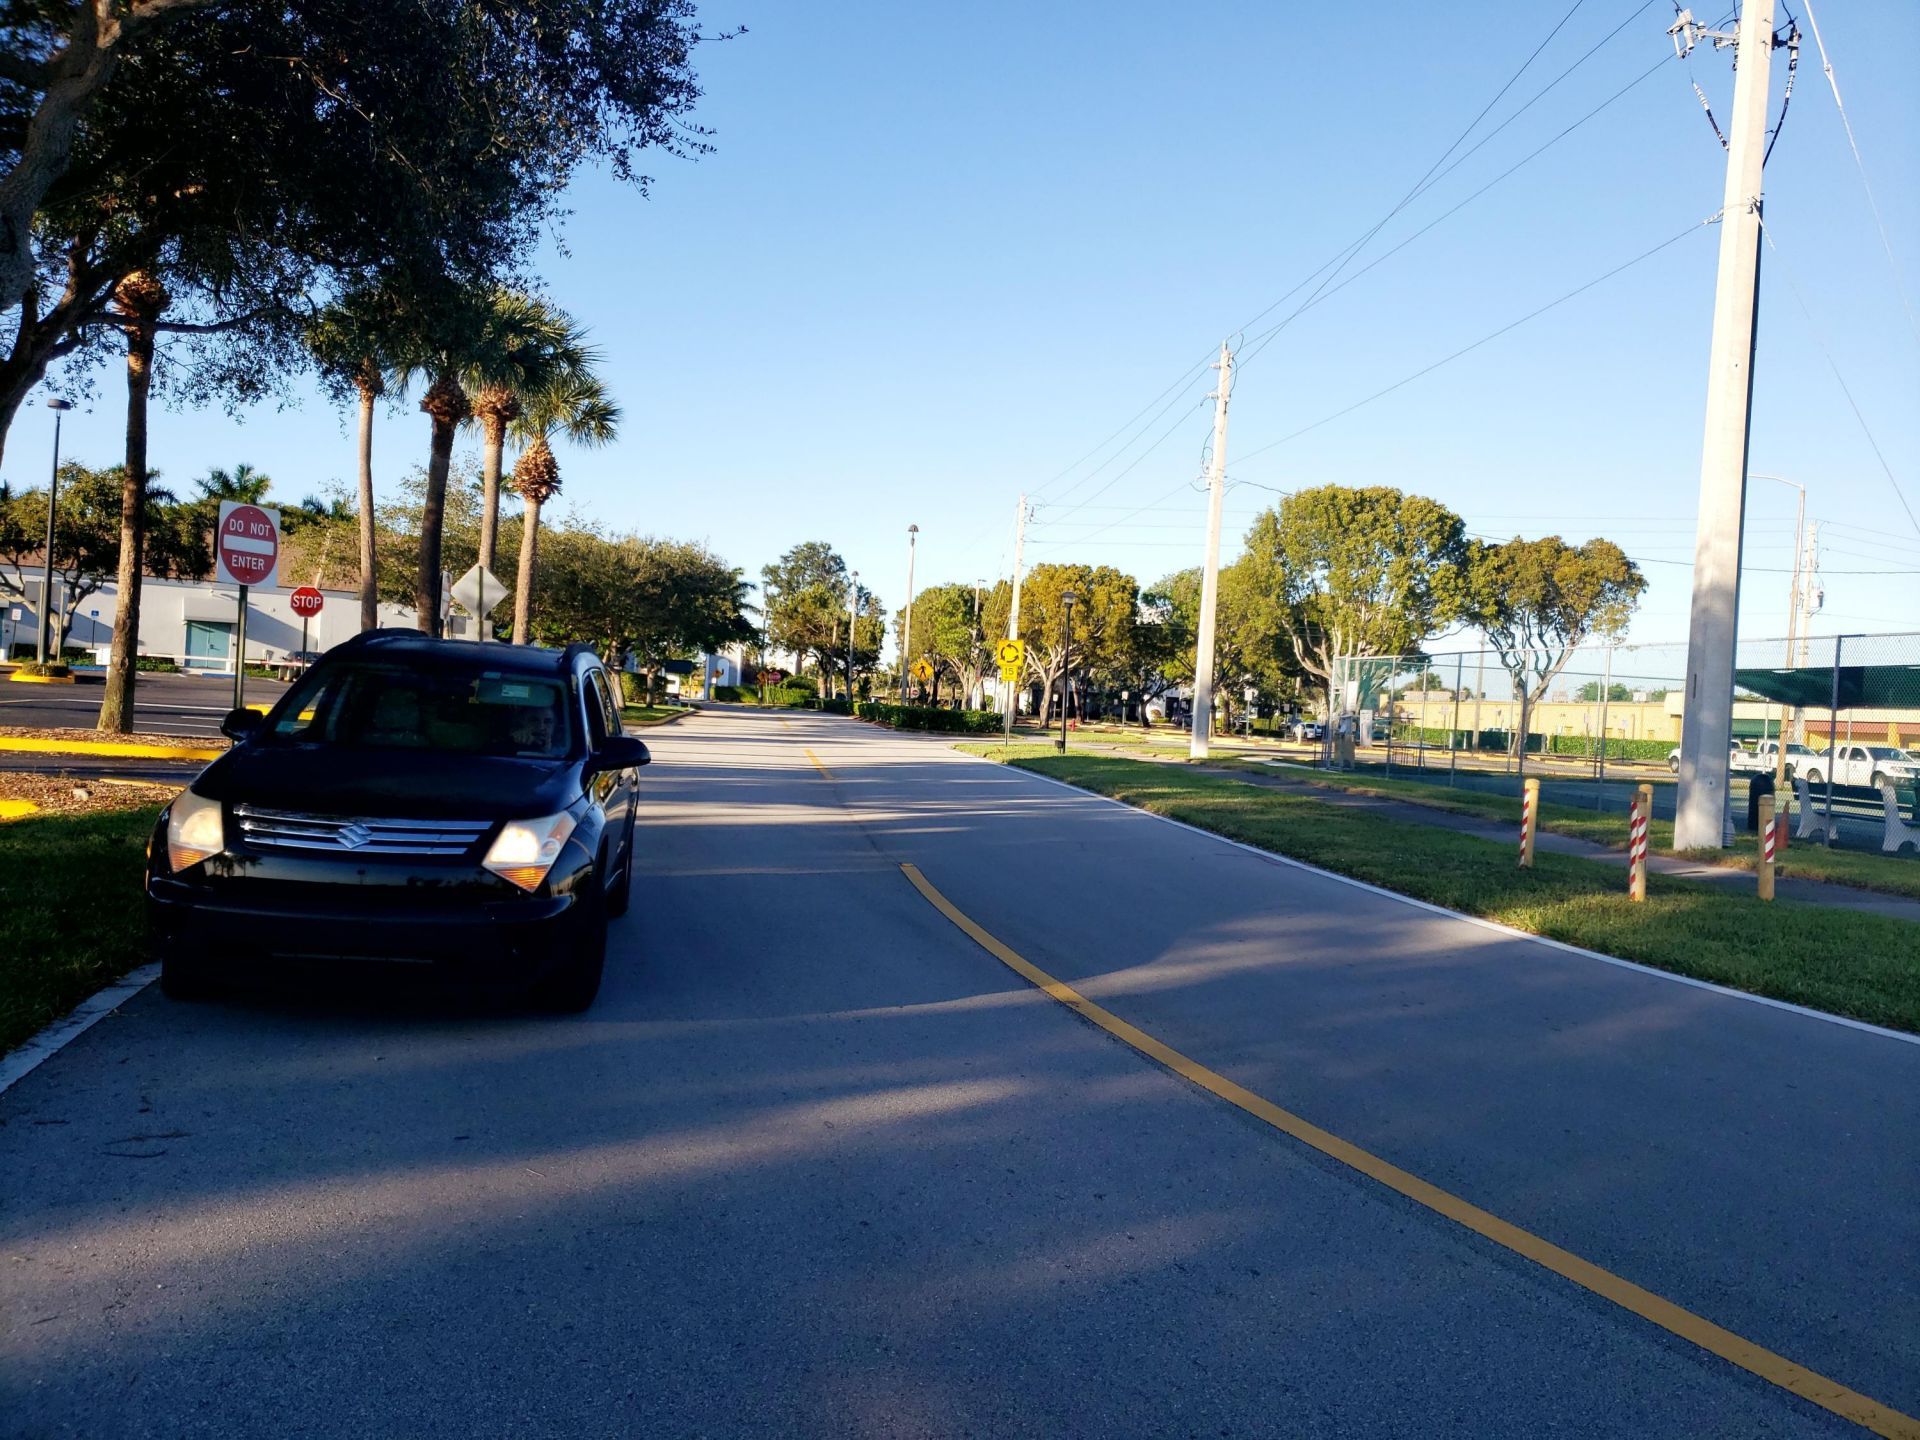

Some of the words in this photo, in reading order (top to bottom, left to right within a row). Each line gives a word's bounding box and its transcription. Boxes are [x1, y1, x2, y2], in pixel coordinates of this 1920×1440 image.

[229, 518, 244, 532] DO
[250, 522, 270, 536] NOT
[231, 554, 264, 571] ENTER
[292, 595, 321, 608] STOP
[1004, 667, 1014, 676] 15
